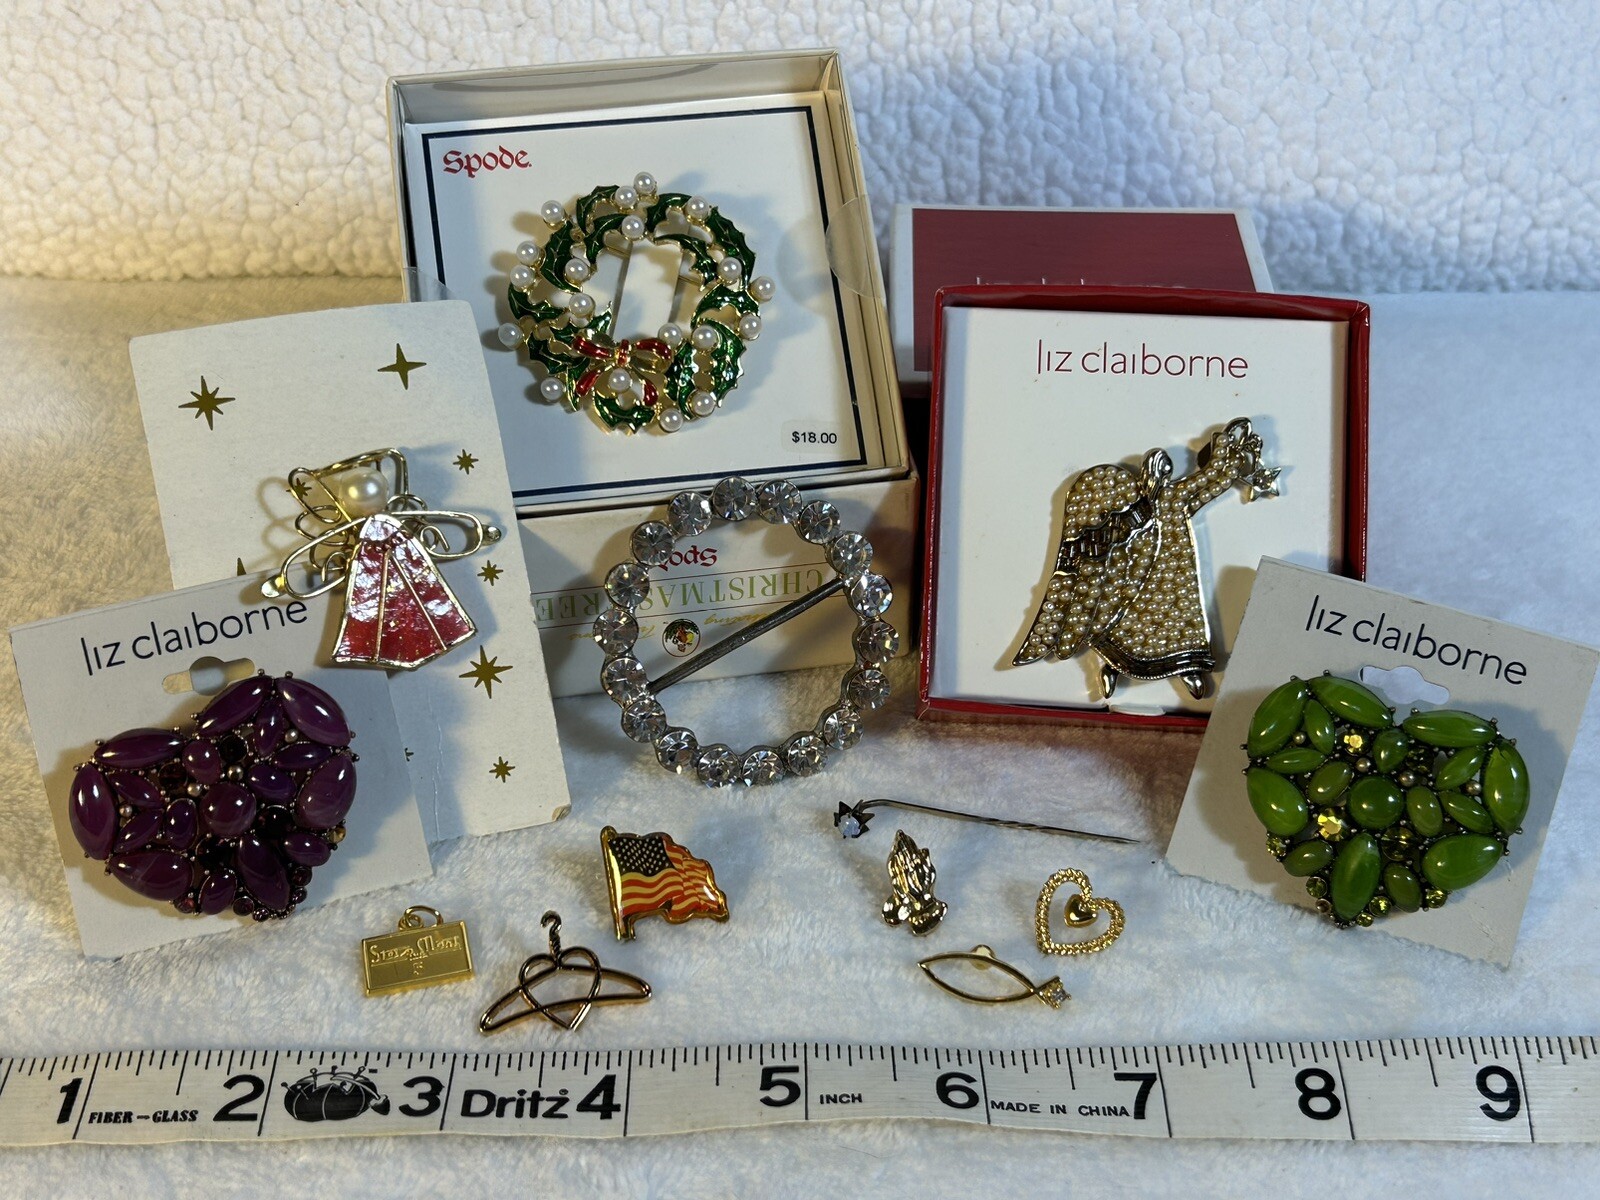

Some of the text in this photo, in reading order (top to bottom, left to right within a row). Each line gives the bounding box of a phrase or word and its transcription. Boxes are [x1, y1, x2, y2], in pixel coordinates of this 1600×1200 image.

[1081, 341, 1249, 379] claiborne
[791, 430, 838, 444] $18.00
[658, 544, 718, 572] Spo
[536, 592, 603, 622] REE
[131, 601, 308, 660] claiborne
[1352, 612, 1528, 685] claiborne
[57, 1077, 83, 1124] 1
[212, 1074, 265, 1121] 2
[398, 1075, 445, 1117] 3
[576, 1074, 621, 1120] 4
[759, 1065, 801, 1107] 5
[819, 1093, 863, 1105] INCH
[936, 1071, 979, 1109] 6
[1113, 1072, 1158, 1120] 7
[1295, 1068, 1341, 1120] 8
[1476, 1065, 1521, 1122] 9
[990, 1100, 1131, 1117] MADE IN CHINA
